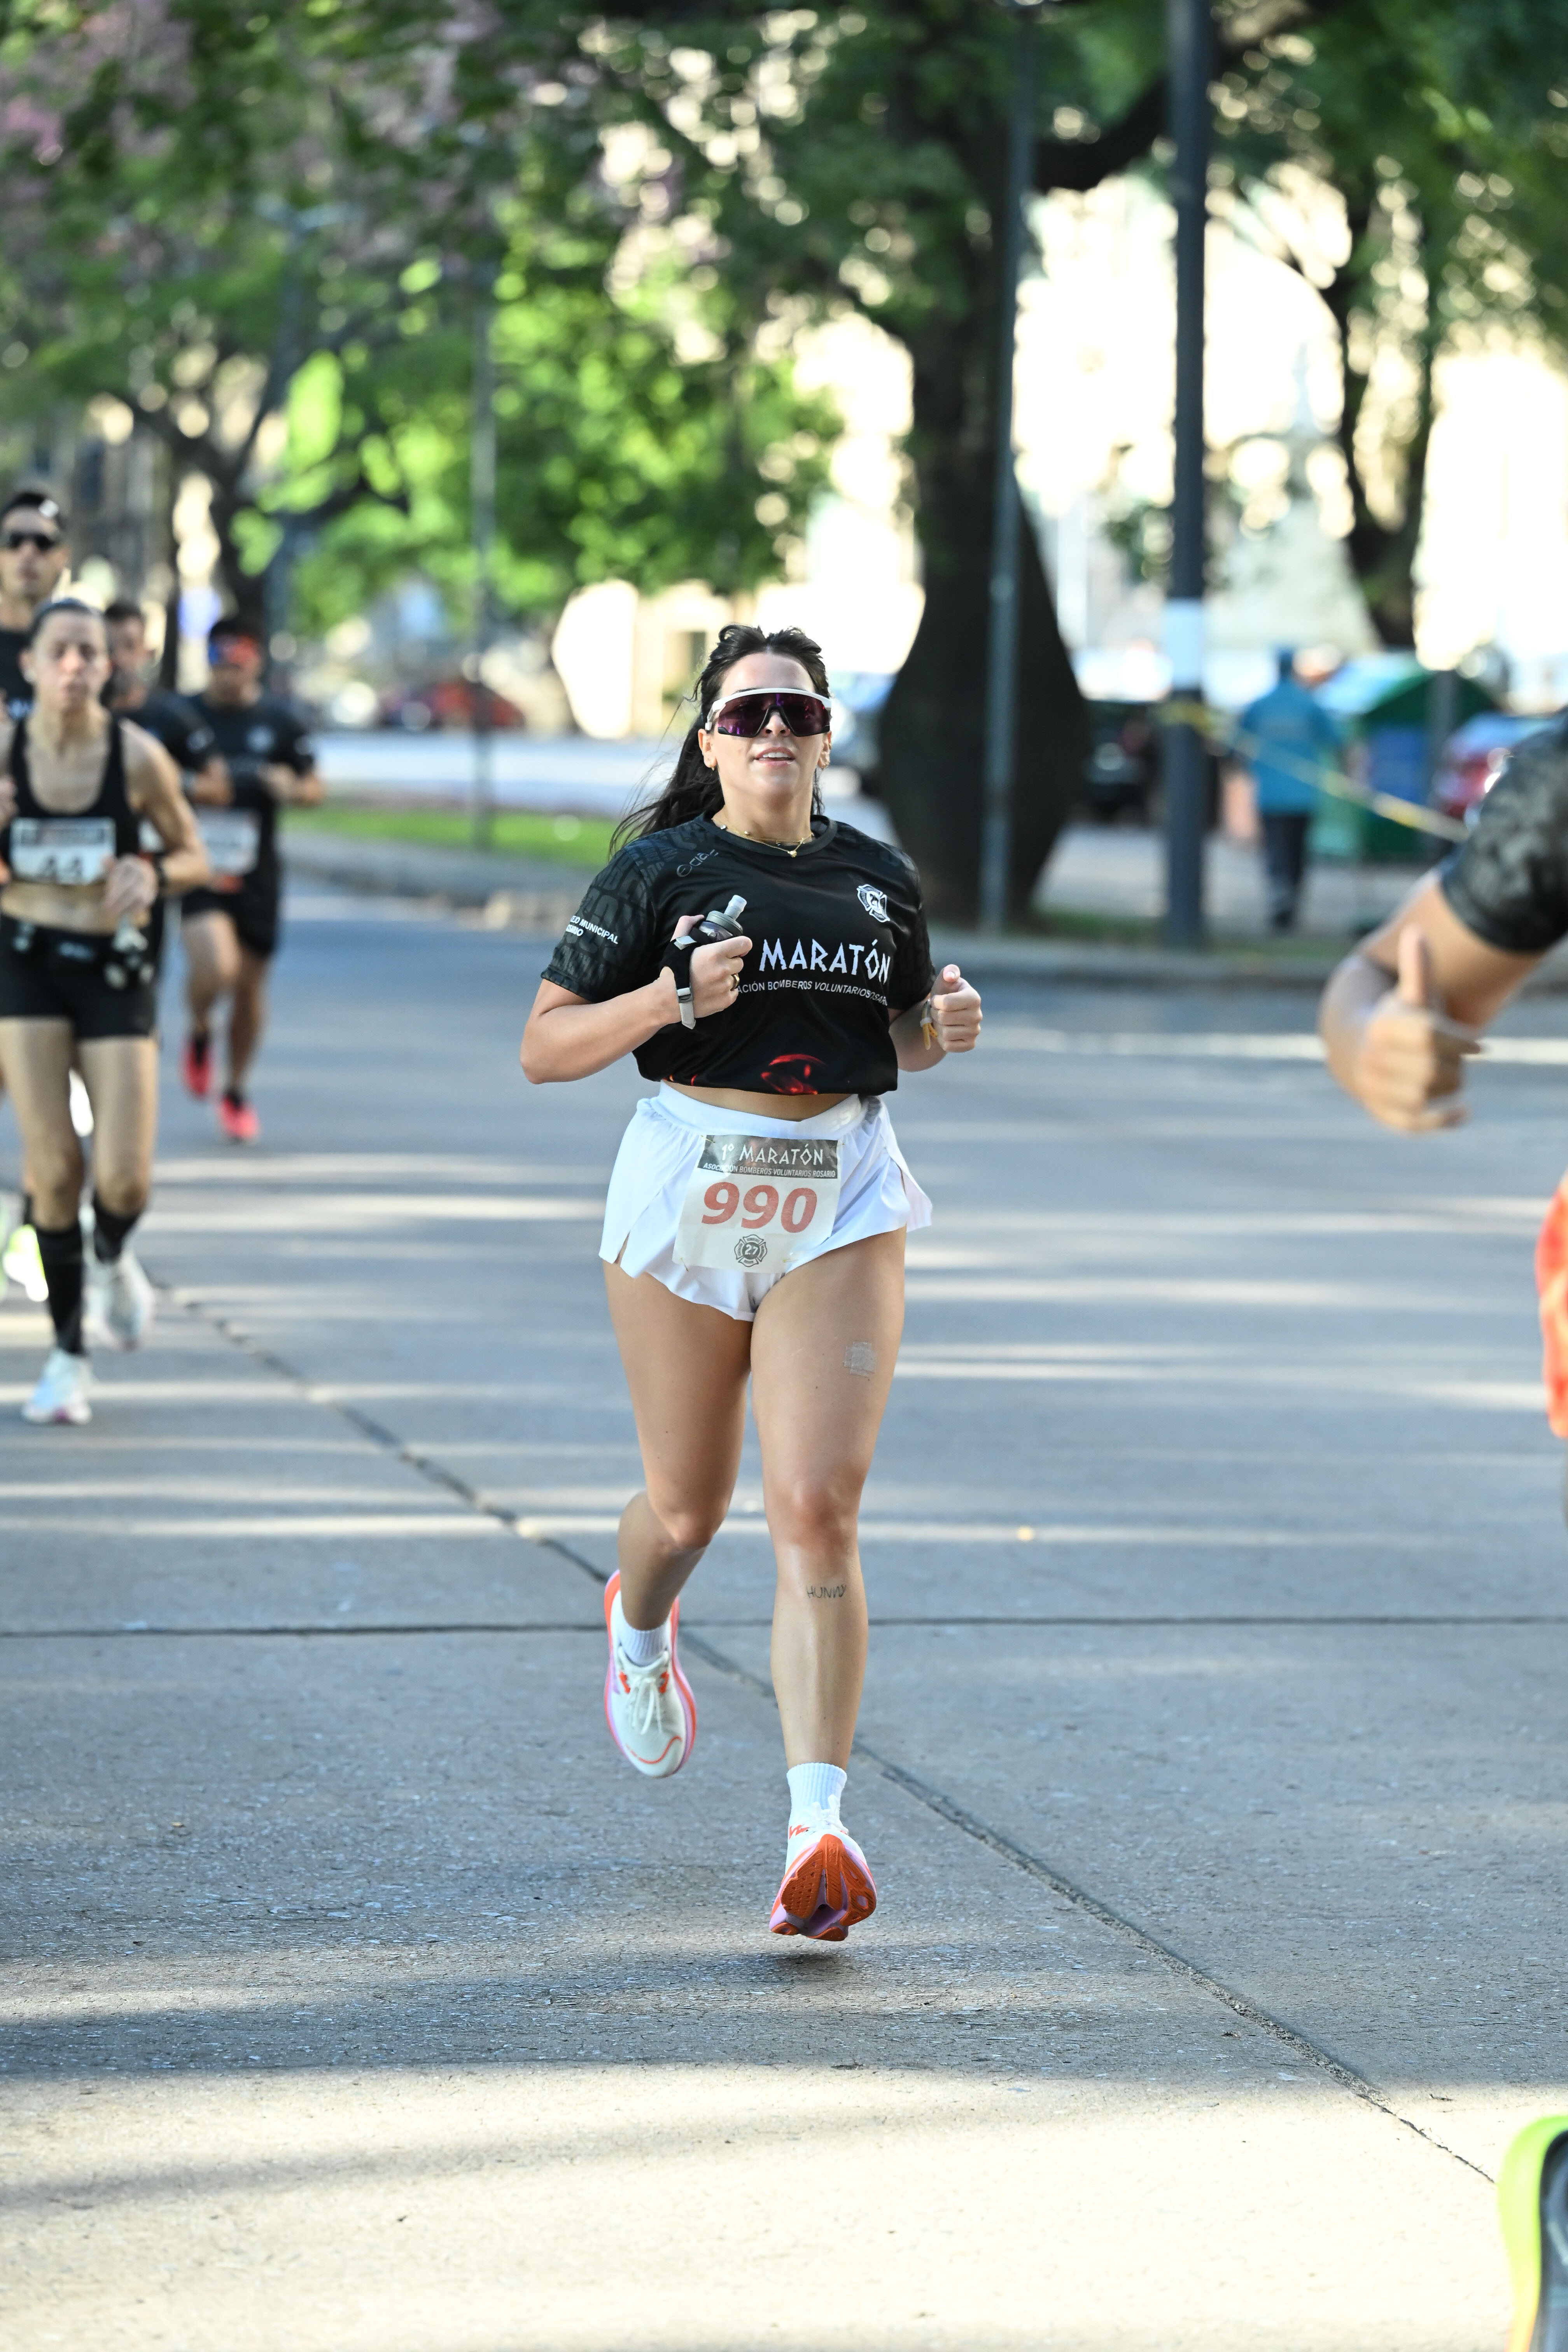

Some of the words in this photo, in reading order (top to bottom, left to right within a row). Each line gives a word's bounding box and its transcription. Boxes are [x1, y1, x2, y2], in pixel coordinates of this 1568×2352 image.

[579, 919, 619, 945] MUNICIPAL
[759, 938, 891, 985] MARATÓN
[767, 979, 813, 990] BOMBEROS
[814, 982, 871, 998] VOLUNTARIOS
[739, 1143, 823, 1166] MARATÓN
[739, 1165, 772, 1176] BOMBEROS
[773, 1168, 812, 1177] VOLUNTARIOS
[812, 1170, 836, 1178] ROSARIO
[701, 1181, 817, 1234] 990
[744, 1244, 758, 1255] 27
